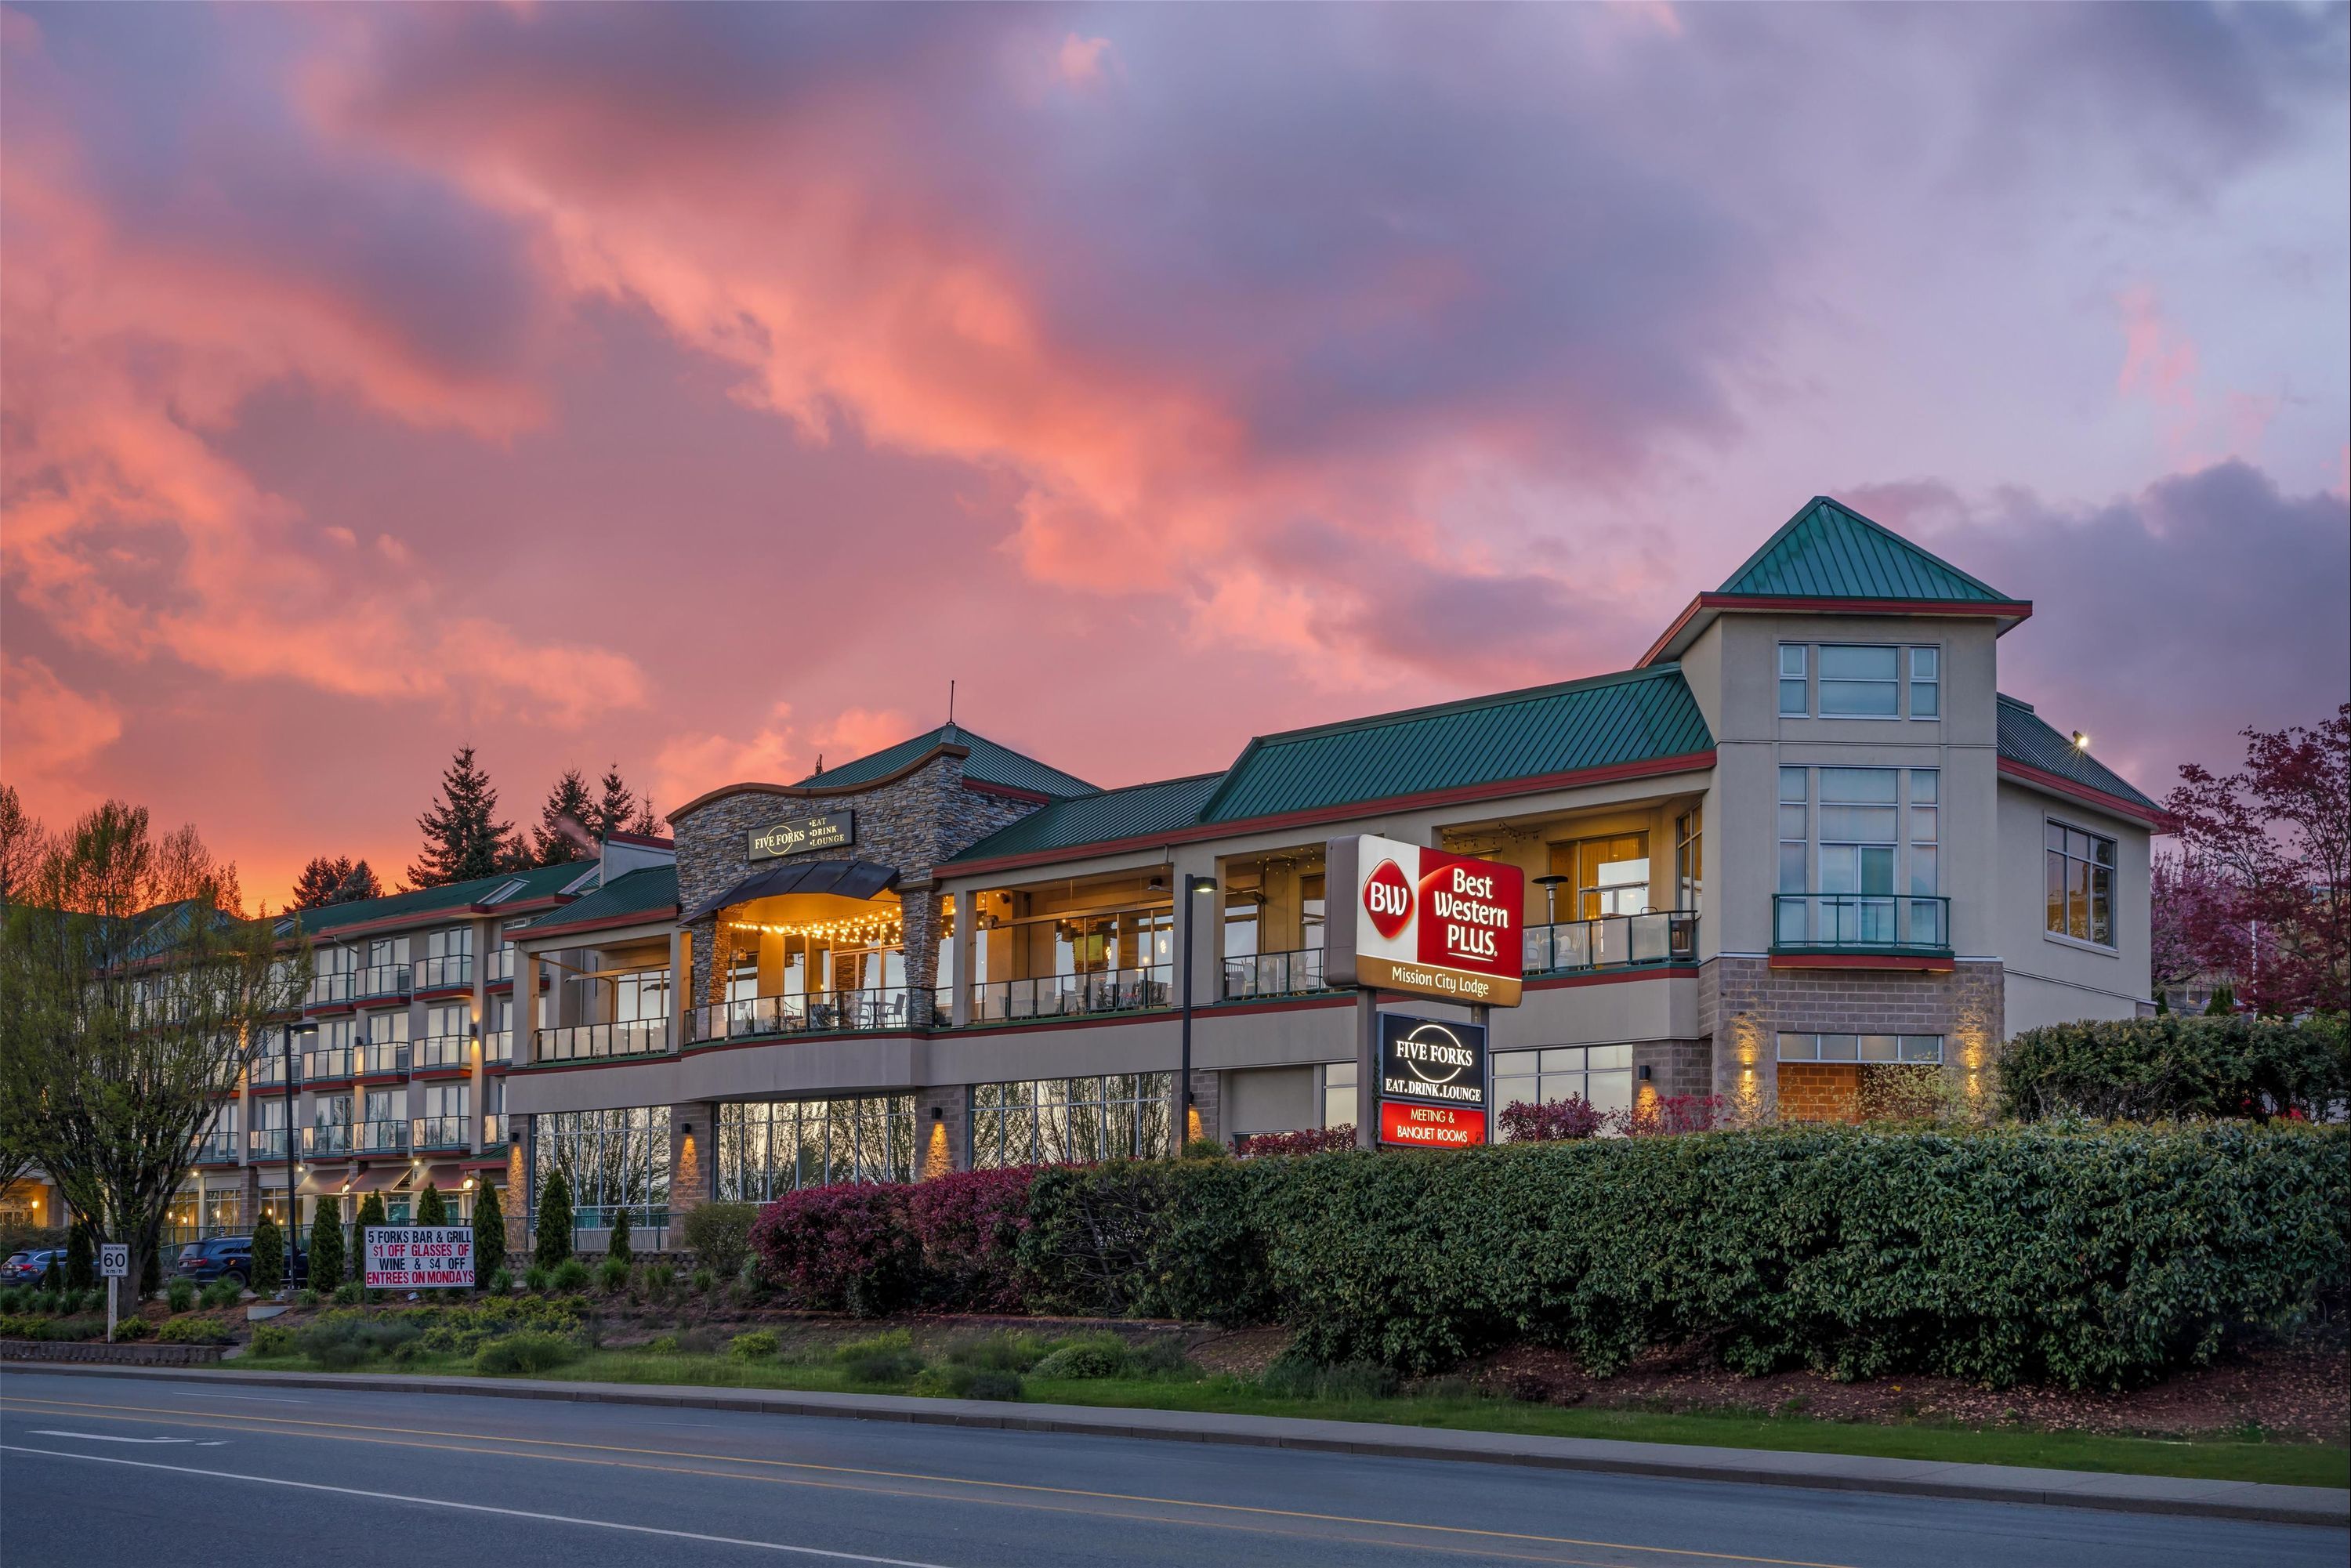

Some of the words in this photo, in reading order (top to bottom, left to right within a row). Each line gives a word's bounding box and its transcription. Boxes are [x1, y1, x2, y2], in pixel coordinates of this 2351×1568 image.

[812, 817, 827, 827] EAT
[812, 825, 837, 837] DRINK
[755, 836, 775, 849] FIVE
[776, 831, 805, 846] FORKS
[812, 835, 845, 846] LOUNGE
[1453, 867, 1493, 900] Best
[1370, 882, 1407, 916] BW
[1433, 890, 1509, 929] Western
[1392, 966, 1433, 987] Mission
[1435, 973, 1457, 994] City
[1459, 976, 1489, 998] Lodge
[1396, 1040, 1428, 1061] FIVE
[1430, 1045, 1473, 1067] FORKS
[1411, 1108, 1446, 1123] MEETING
[1448, 1111, 1455, 1124] &
[1397, 1125, 1435, 1141] BANQUET
[1437, 1129, 1468, 1143] ROOMS
[368, 1231, 375, 1244] 5
[378, 1231, 409, 1244] FORKS
[412, 1231, 433, 1244] BAR
[437, 1231, 444, 1244] &
[447, 1231, 472, 1244] GRILL
[373, 1244, 383, 1258] $1
[388, 1244, 406, 1257] OFF
[411, 1244, 452, 1257] GLASSES
[458, 1244, 469, 1256] OF
[103, 1253, 125, 1267] 60
[379, 1258, 405, 1270] WINE
[414, 1258, 422, 1270] &
[429, 1258, 441, 1269] $4
[448, 1258, 465, 1269] OFF
[367, 1272, 408, 1284] ENTREES
[411, 1272, 426, 1284] ON
[427, 1270, 474, 1284] MONDAYS
